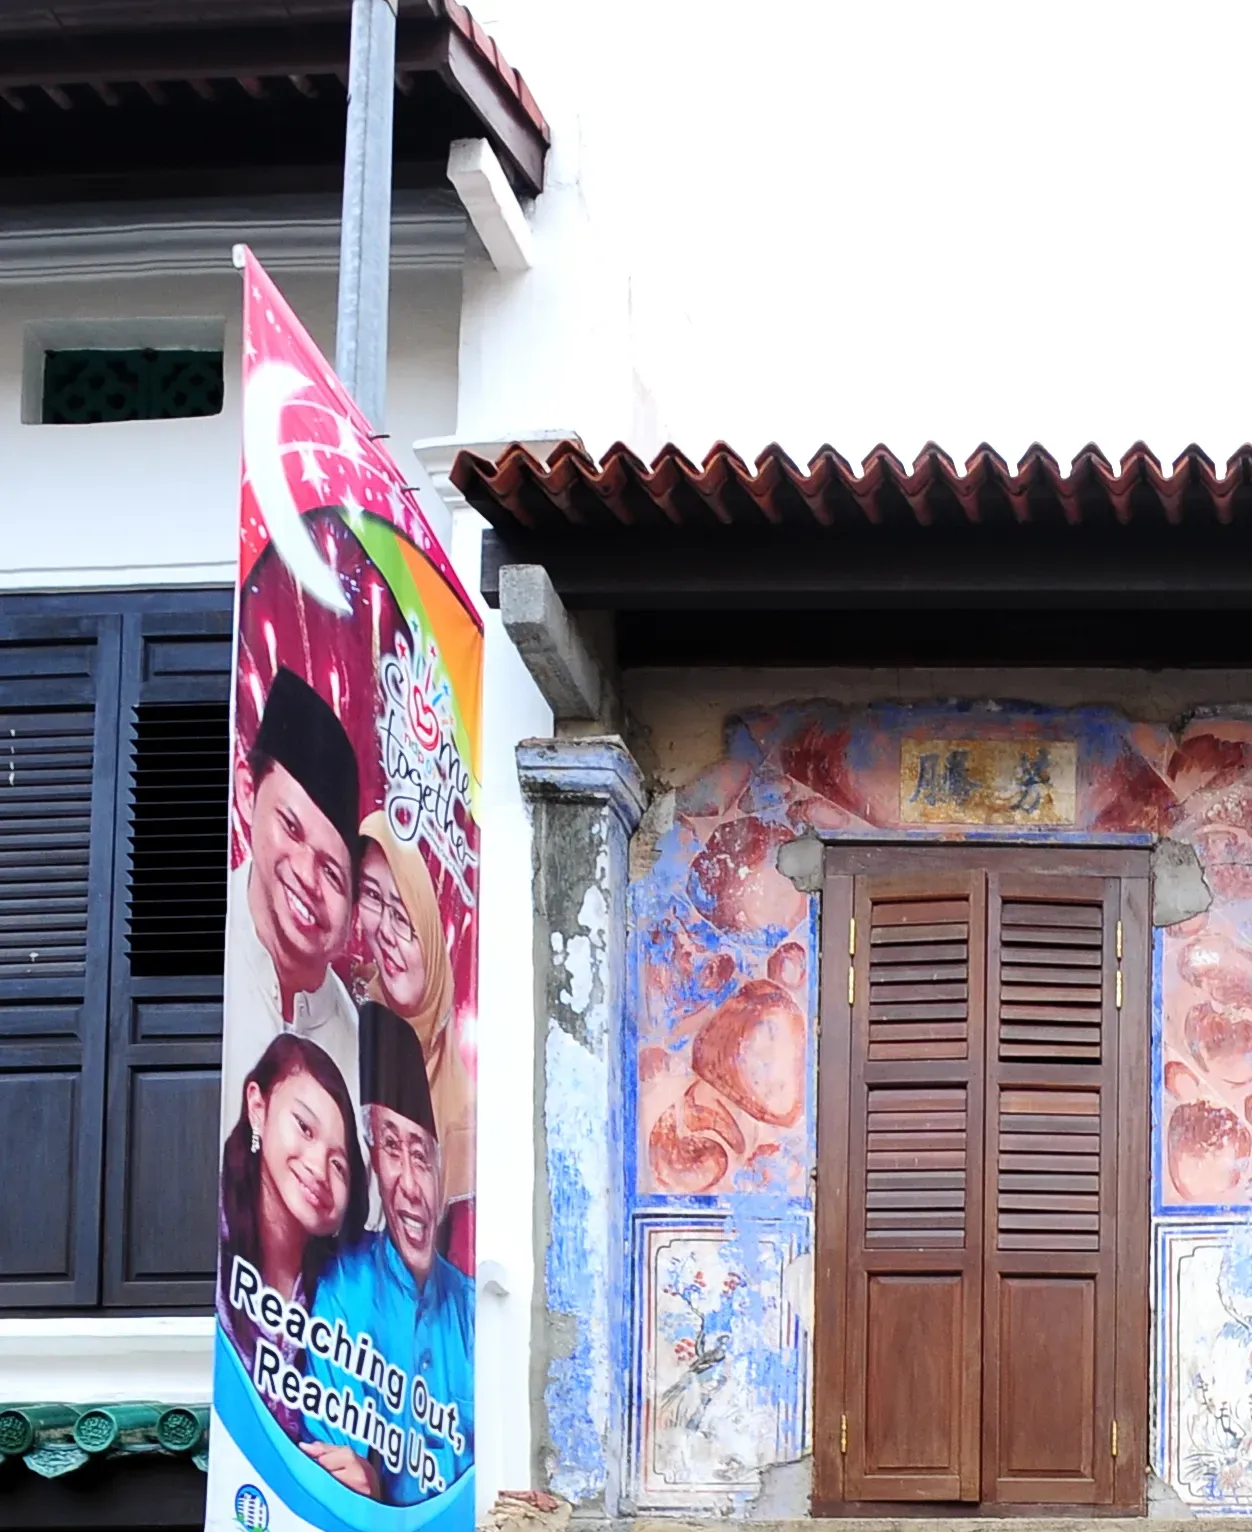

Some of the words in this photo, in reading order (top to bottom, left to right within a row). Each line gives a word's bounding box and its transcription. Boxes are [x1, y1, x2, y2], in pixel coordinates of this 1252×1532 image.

[380, 708, 476, 867] together
[233, 1260, 404, 1409] Reaching
[412, 1376, 464, 1451] Out,
[257, 1350, 402, 1469] Reaching
[409, 1434, 445, 1491] Up.
